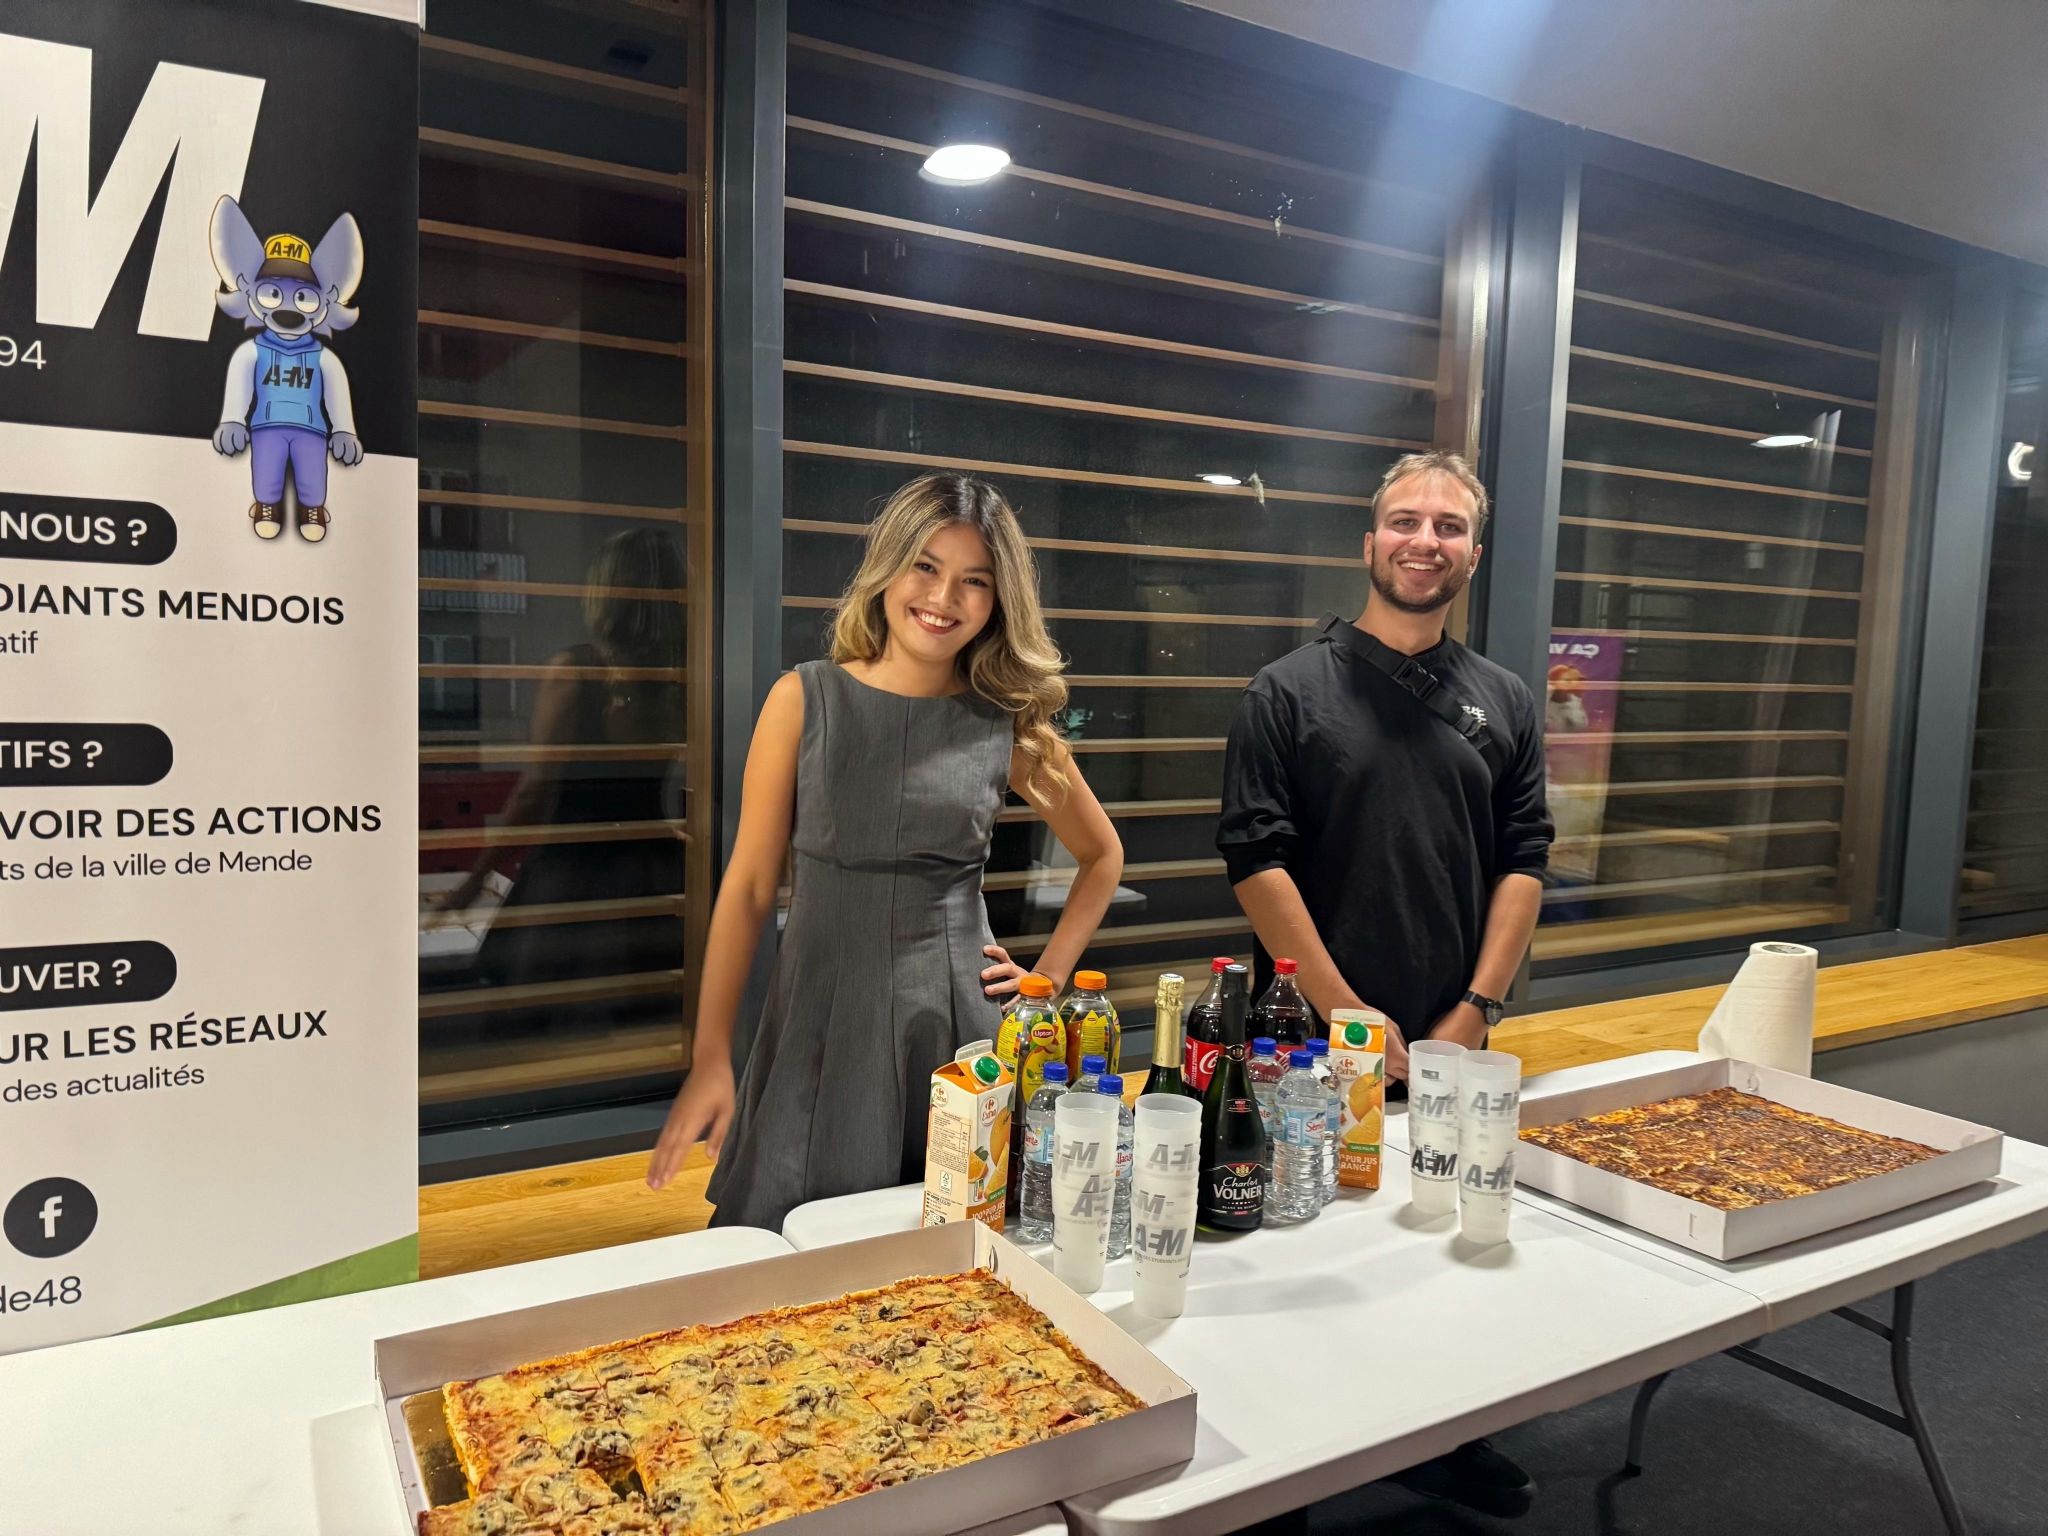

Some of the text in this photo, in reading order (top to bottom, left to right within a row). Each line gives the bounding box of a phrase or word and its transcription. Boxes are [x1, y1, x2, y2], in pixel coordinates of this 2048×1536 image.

[0, 511, 148, 547] NOUS ?
[159, 589, 344, 626] MENDOIS
[82, 740, 103, 769] ?
[0, 804, 382, 841] VOIR DES ACTIONS
[34, 855, 73, 880] de
[82, 854, 105, 878] la
[113, 853, 167, 877] ville
[174, 852, 211, 875] de
[219, 849, 313, 874] Mende
[0, 958, 133, 994] UVER ?
[63, 1025, 137, 1059] LES
[150, 1010, 328, 1052] RÉSEAUX
[1034, 1029, 1053, 1037] Lipton
[2, 1064, 205, 1103] des actualités
[1212, 1183, 1263, 1200] VOLNER
[1222, 1176, 1258, 1187] Charles
